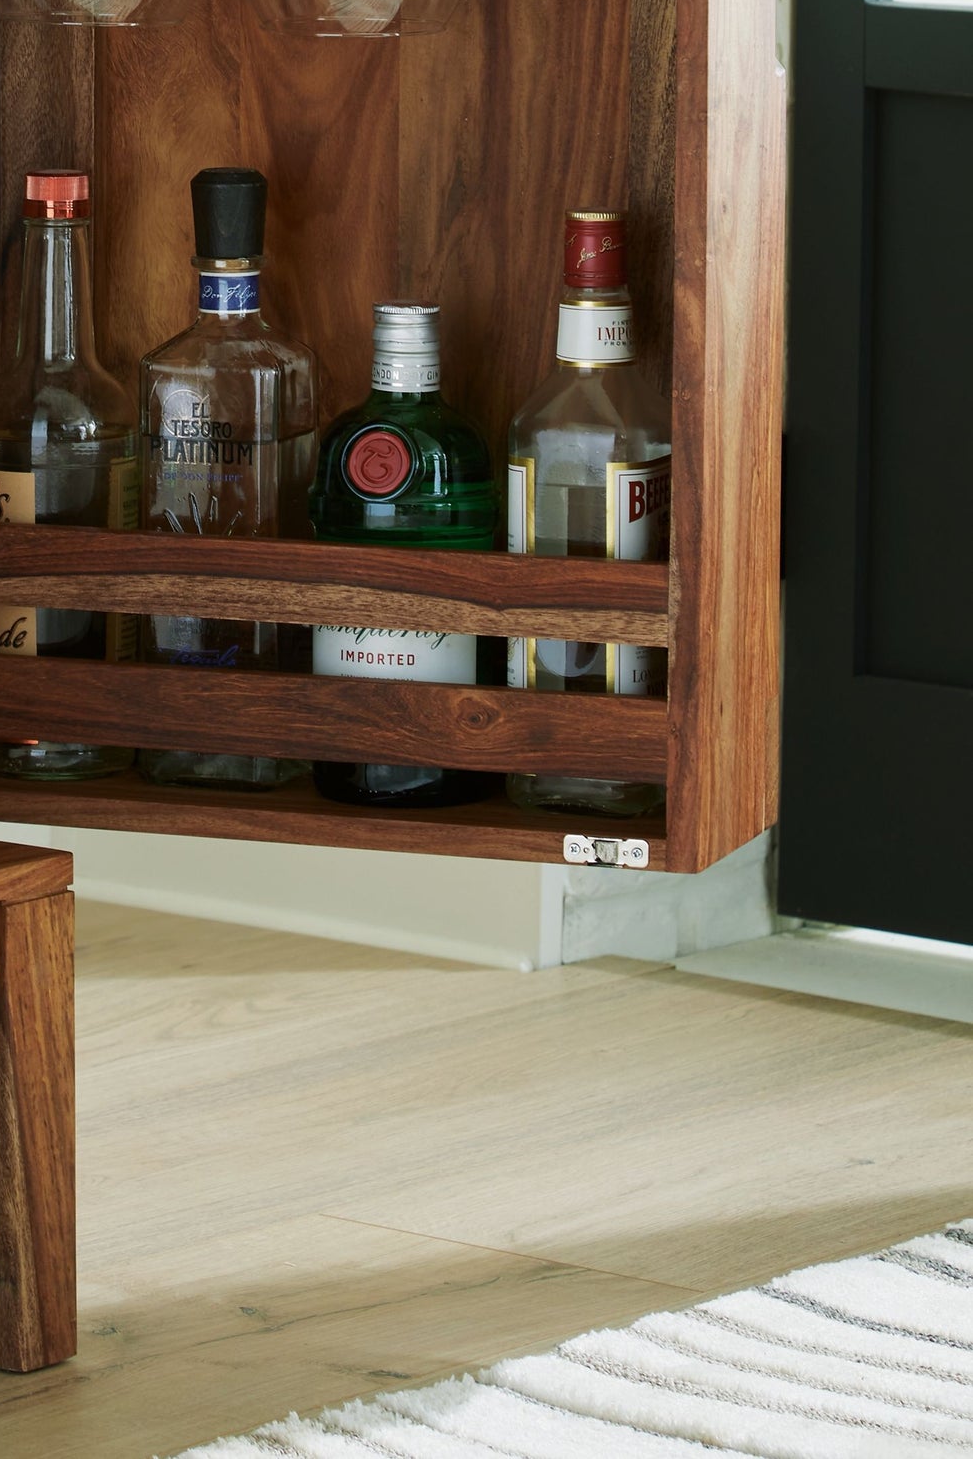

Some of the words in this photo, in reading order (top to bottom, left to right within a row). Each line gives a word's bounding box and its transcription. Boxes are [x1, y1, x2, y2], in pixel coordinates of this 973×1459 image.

[191, 402, 212, 419] EL
[171, 419, 233, 439] TESORO
[149, 436, 254, 466] PLATINUM
[340, 649, 416, 666] IMPORTED
